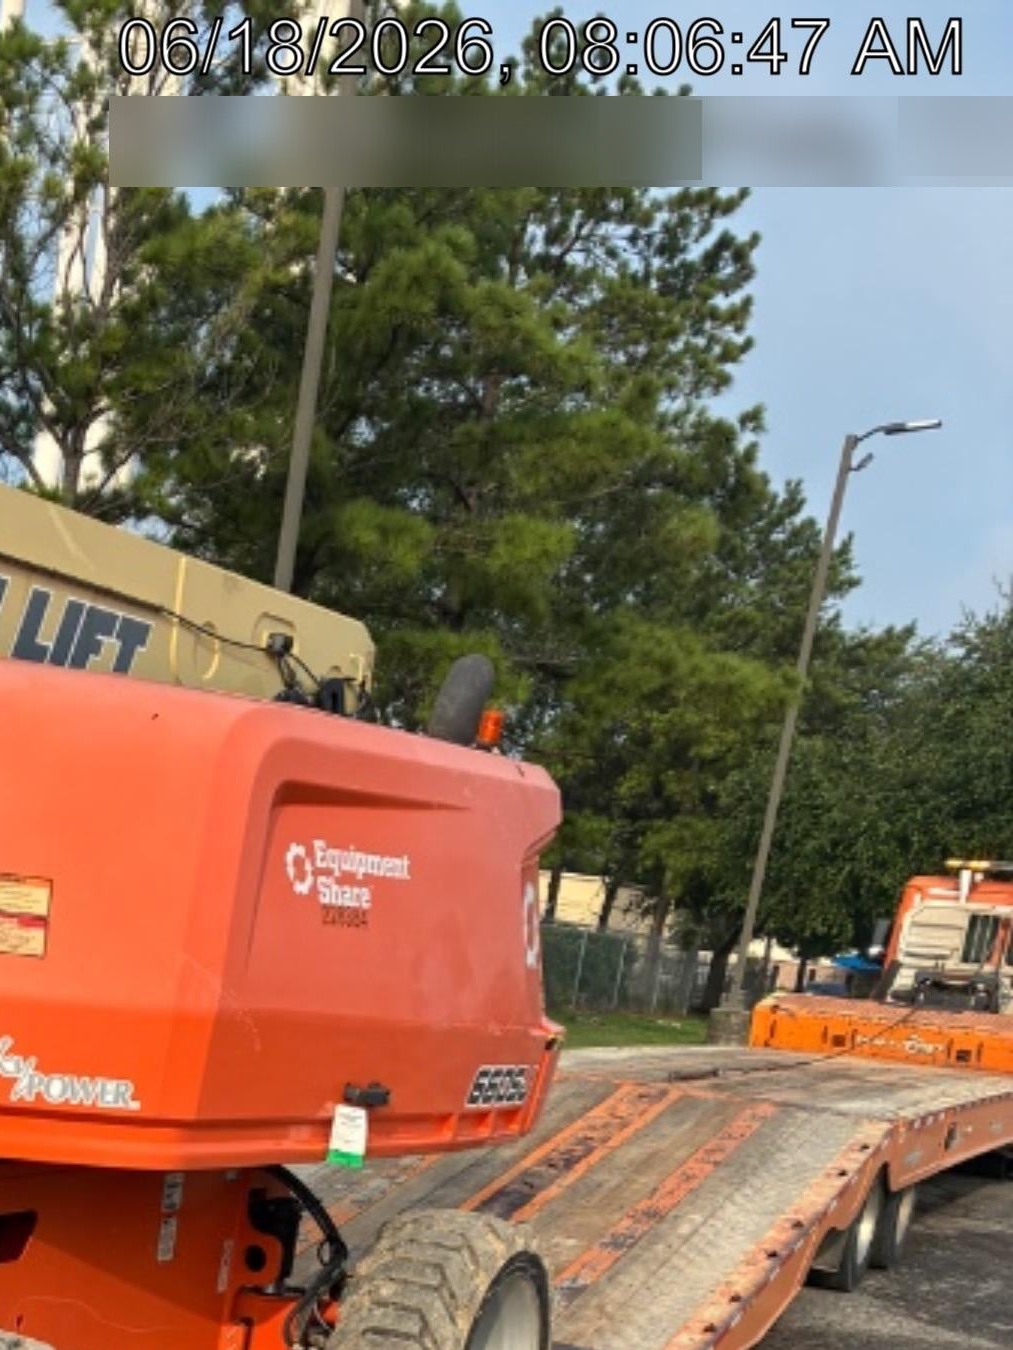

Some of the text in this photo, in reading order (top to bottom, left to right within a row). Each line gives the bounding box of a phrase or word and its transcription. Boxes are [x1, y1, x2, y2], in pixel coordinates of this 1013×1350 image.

[11, 585, 155, 675] LIFT
[314, 840, 411, 879] Equipment
[318, 876, 372, 909] Share
